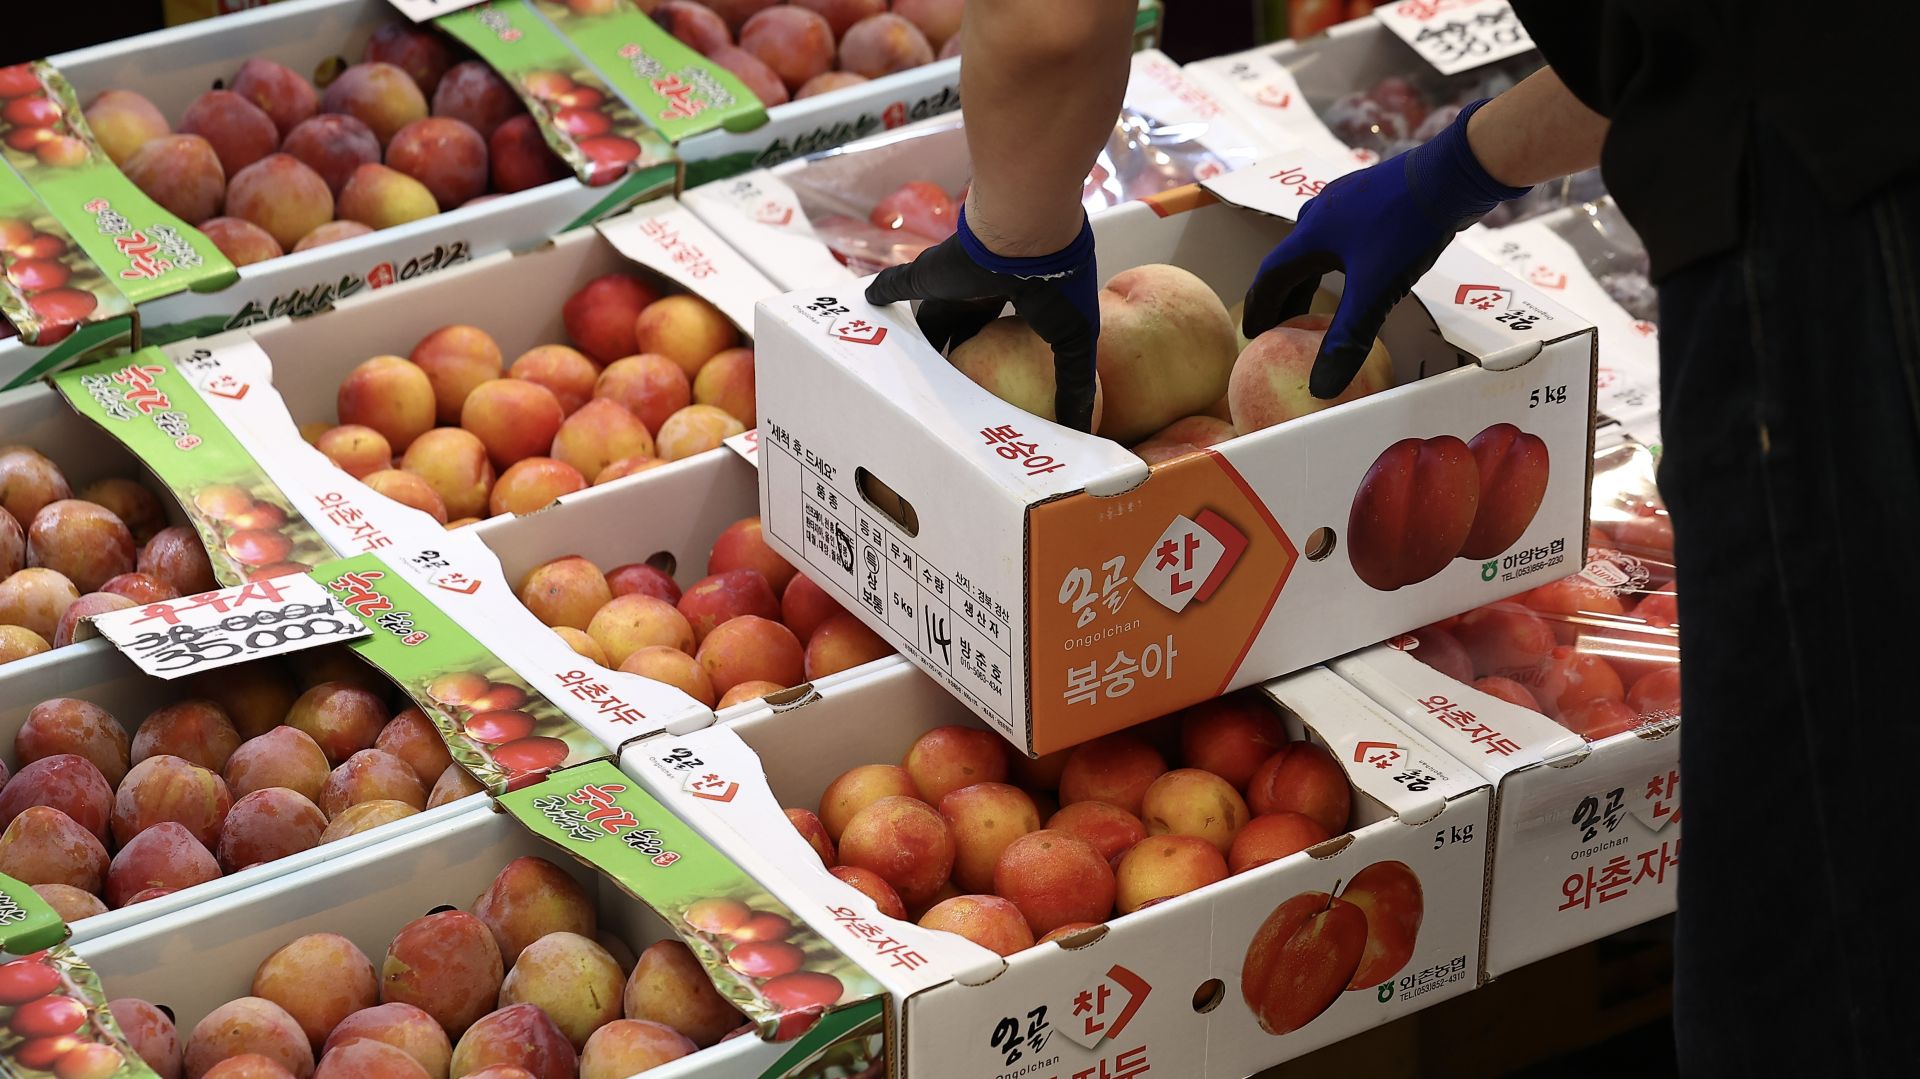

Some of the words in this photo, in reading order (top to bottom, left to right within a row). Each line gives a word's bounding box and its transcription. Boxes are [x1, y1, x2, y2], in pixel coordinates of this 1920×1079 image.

[792, 438, 803, 457] 후
[979, 423, 1066, 476] 복숭아
[314, 491, 394, 552] 와촌자두
[1155, 532, 1200, 596] 찬
[1502, 537, 1565, 570] 하양농협
[924, 603, 952, 667] 14
[1063, 618, 1141, 651] Ongolchan
[554, 669, 647, 726] 와촌자두
[1063, 634, 1179, 706] 복숭아
[1416, 694, 1522, 757] 와촌자두
[566, 783, 641, 835] 자두
[1557, 837, 1682, 913] 와촌자
[1570, 835, 1630, 861] Ongolchan
[824, 904, 930, 972] 와촌자두
[1399, 954, 1467, 993] 와촌농협
[1072, 982, 1112, 1037] 찬
